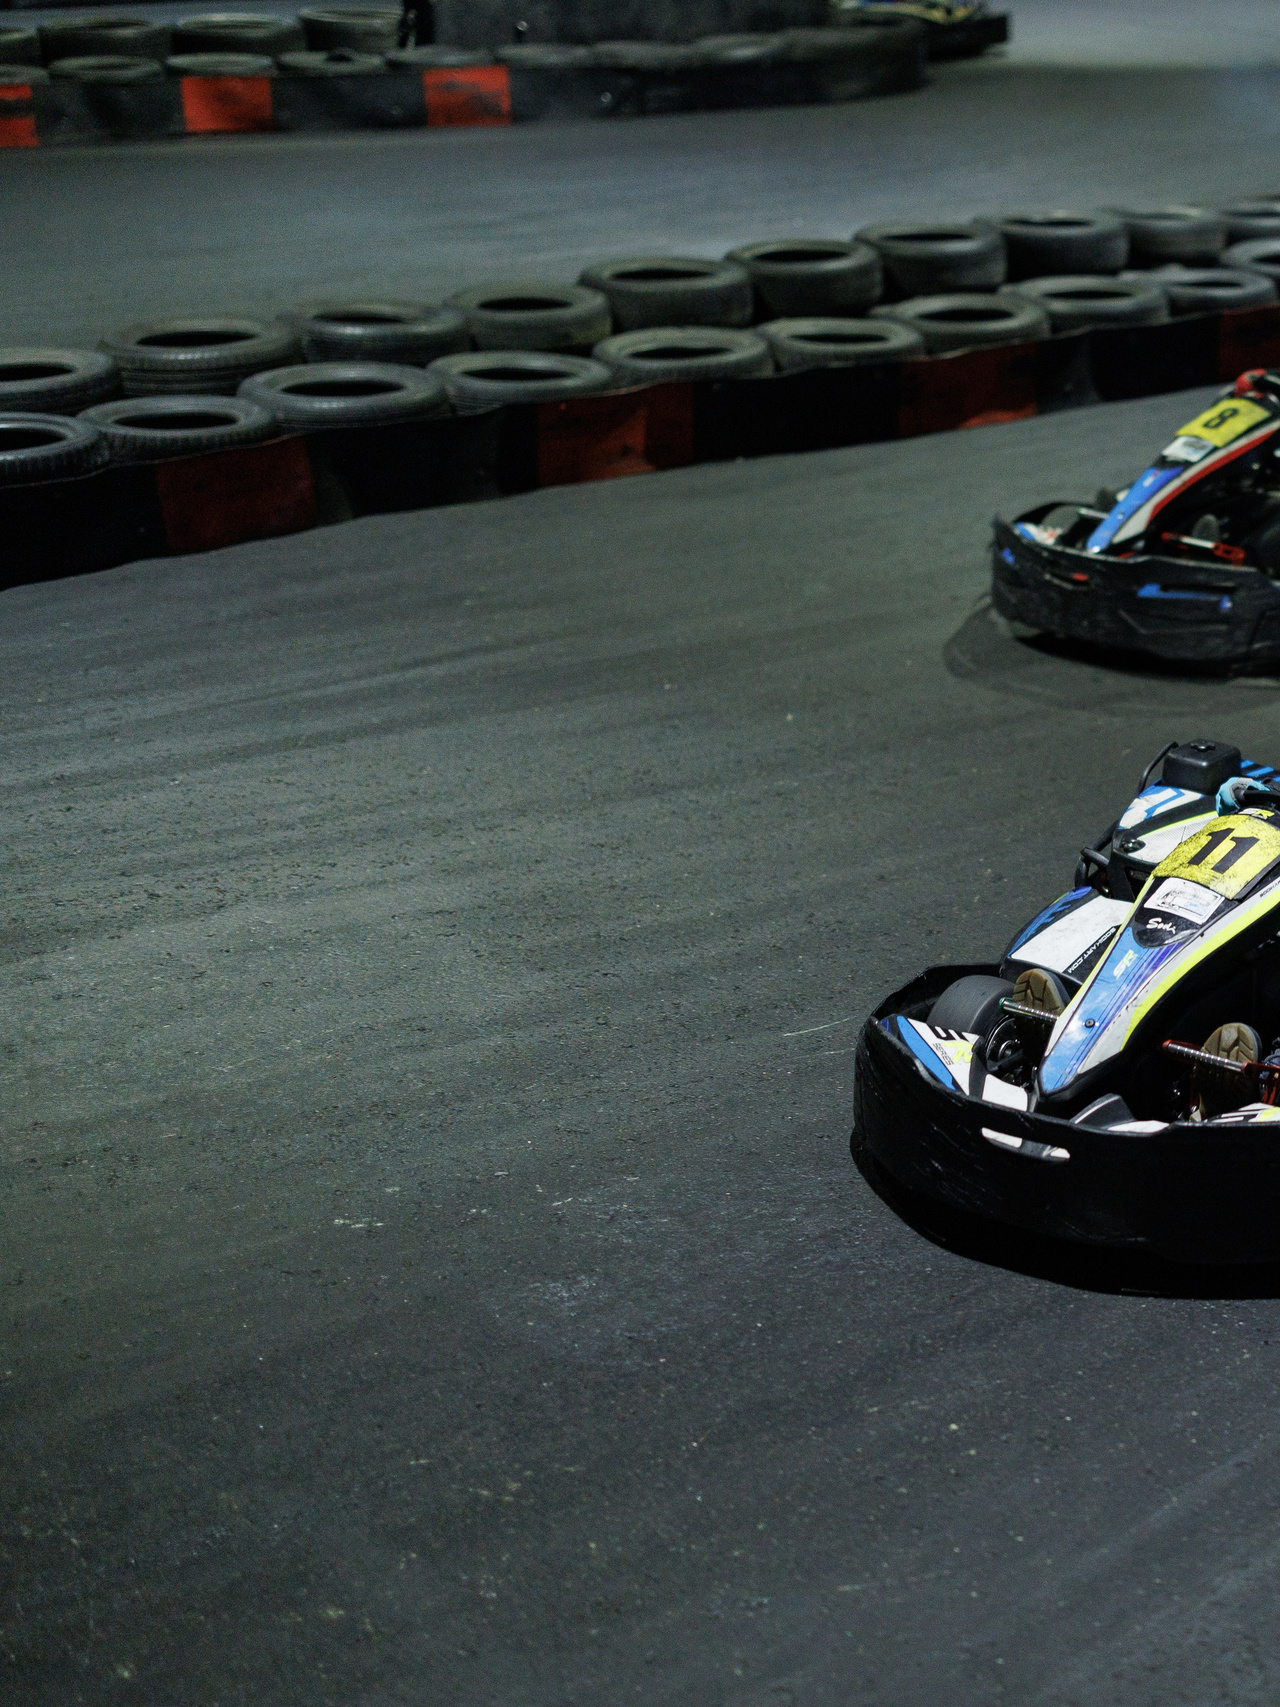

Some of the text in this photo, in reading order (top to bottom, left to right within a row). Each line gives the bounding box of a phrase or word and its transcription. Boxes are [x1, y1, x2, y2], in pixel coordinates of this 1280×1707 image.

[1202, 407, 1239, 429] 8
[1187, 827, 1260, 875] 11
[1146, 917, 1177, 934] Sodi
[932, 1042, 955, 1066] SERIES
